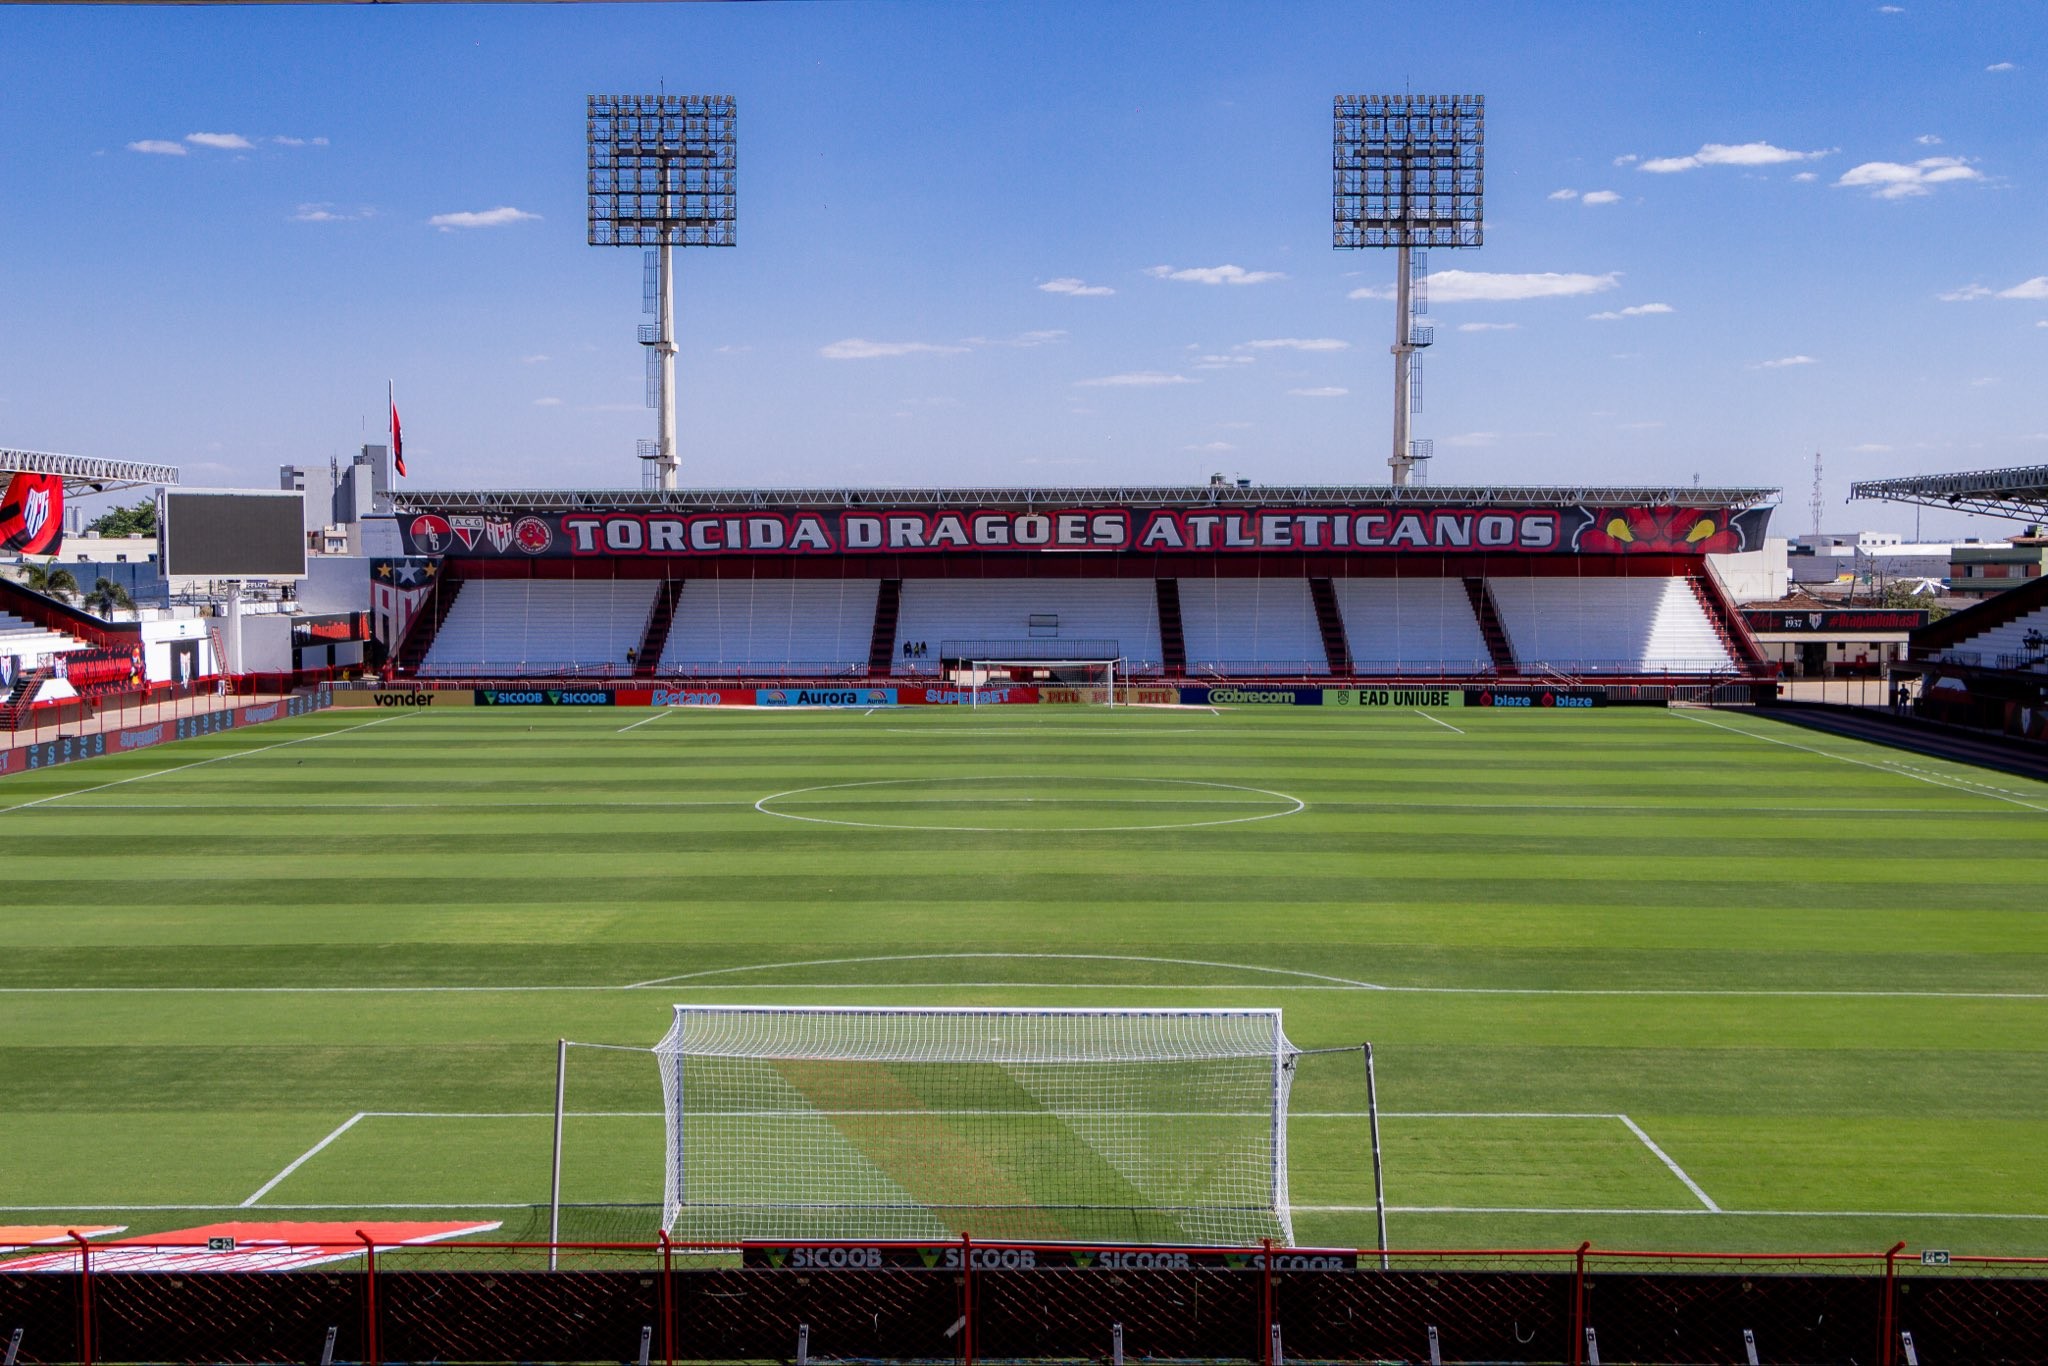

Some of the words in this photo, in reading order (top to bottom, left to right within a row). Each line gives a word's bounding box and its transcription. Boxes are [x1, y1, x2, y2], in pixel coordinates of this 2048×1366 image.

[568, 519, 830, 551] TORCIDA
[1142, 515, 1553, 547] ATLETICANOS
[1785, 619, 1802, 628] 1937
[374, 690, 434, 706] vonder
[498, 692, 543, 704] SICOOB
[562, 692, 607, 704] SICOOB
[651, 689, 721, 705] Betano
[797, 690, 857, 705] Aurora
[925, 689, 1010, 705] SUPERBET
[1208, 689, 1296, 704] cobrecom
[1359, 691, 1389, 706] EAD
[1394, 691, 1450, 706] UNIUBE
[1494, 695, 1532, 706] blaze
[1556, 696, 1593, 707] blaze
[792, 1247, 883, 1268] SICOOB
[1099, 1251, 1189, 1270] SICOOB
